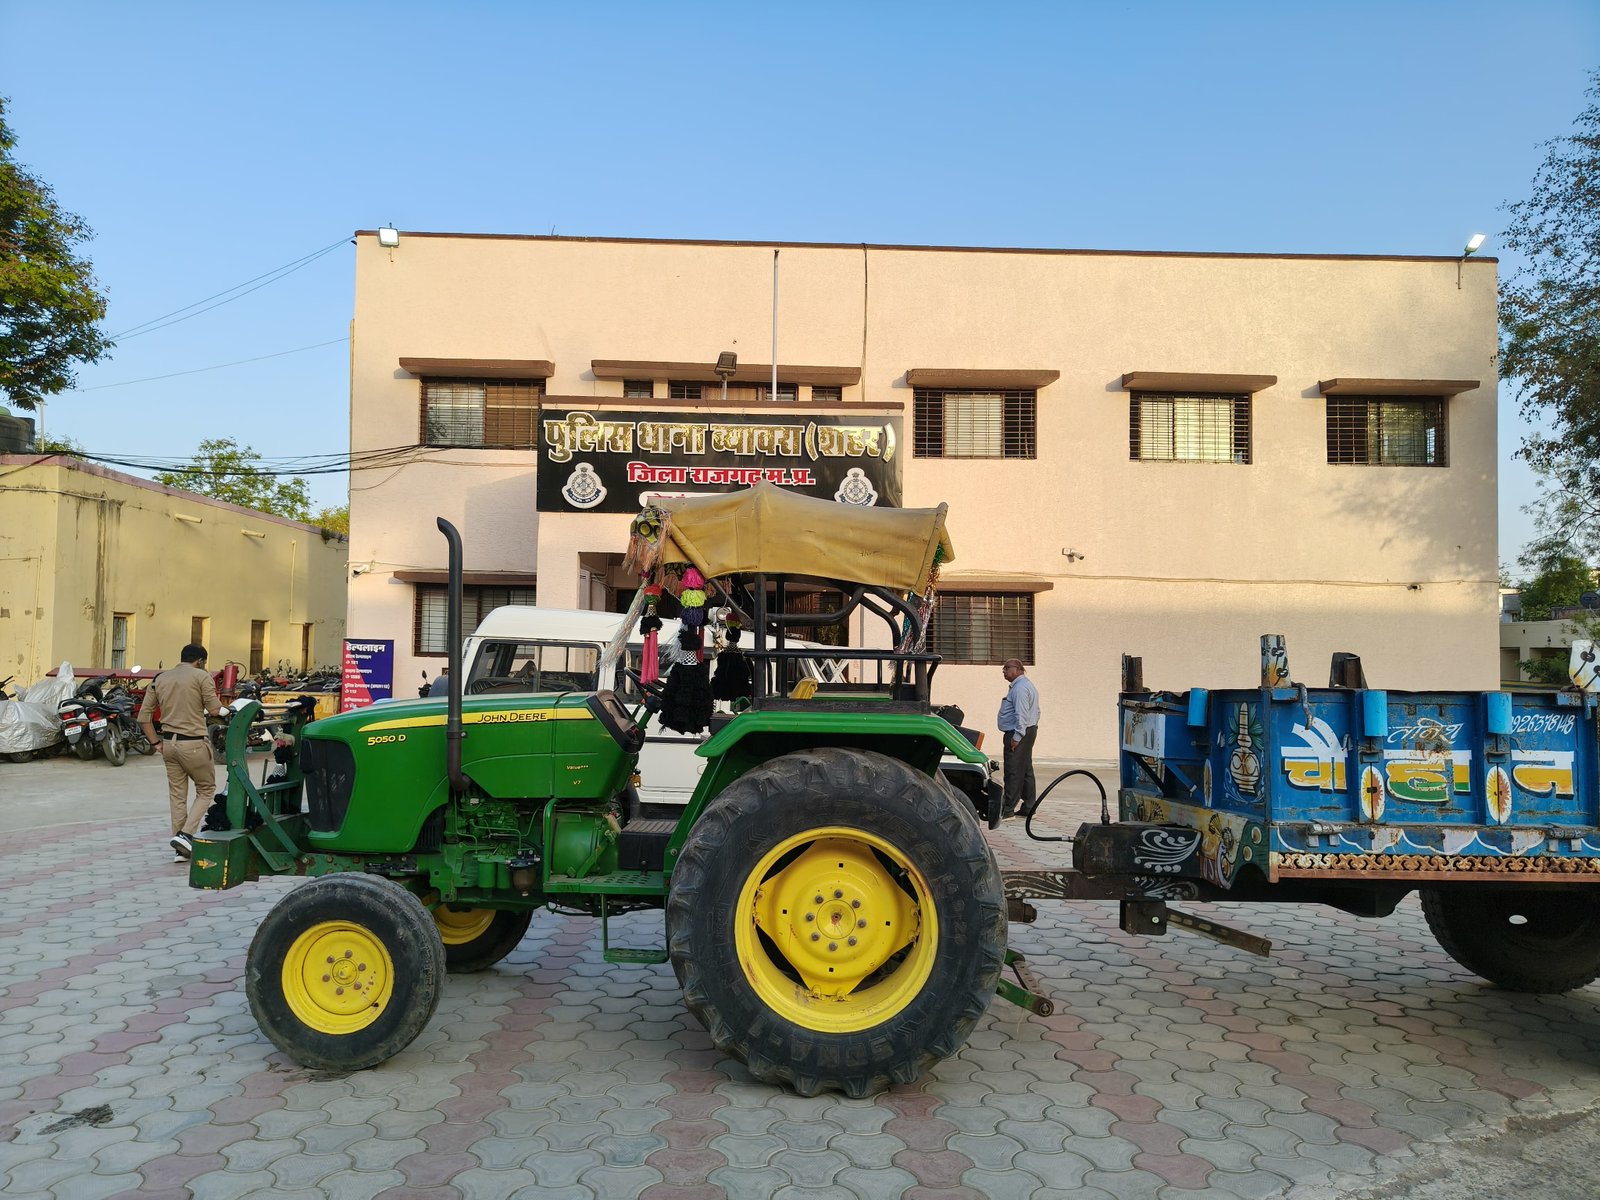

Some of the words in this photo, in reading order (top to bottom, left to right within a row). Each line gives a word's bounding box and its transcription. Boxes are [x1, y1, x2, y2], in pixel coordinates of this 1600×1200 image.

[544, 412, 636, 463] पुलिस
[637, 422, 708, 454] थाना
[805, 421, 896, 462] (शहर)
[626, 461, 688, 484] जिला
[478, 713, 507, 722] JOHN
[510, 712, 547, 721] DEERE
[367, 735, 396, 746] 5050
[398, 734, 406, 742] D
